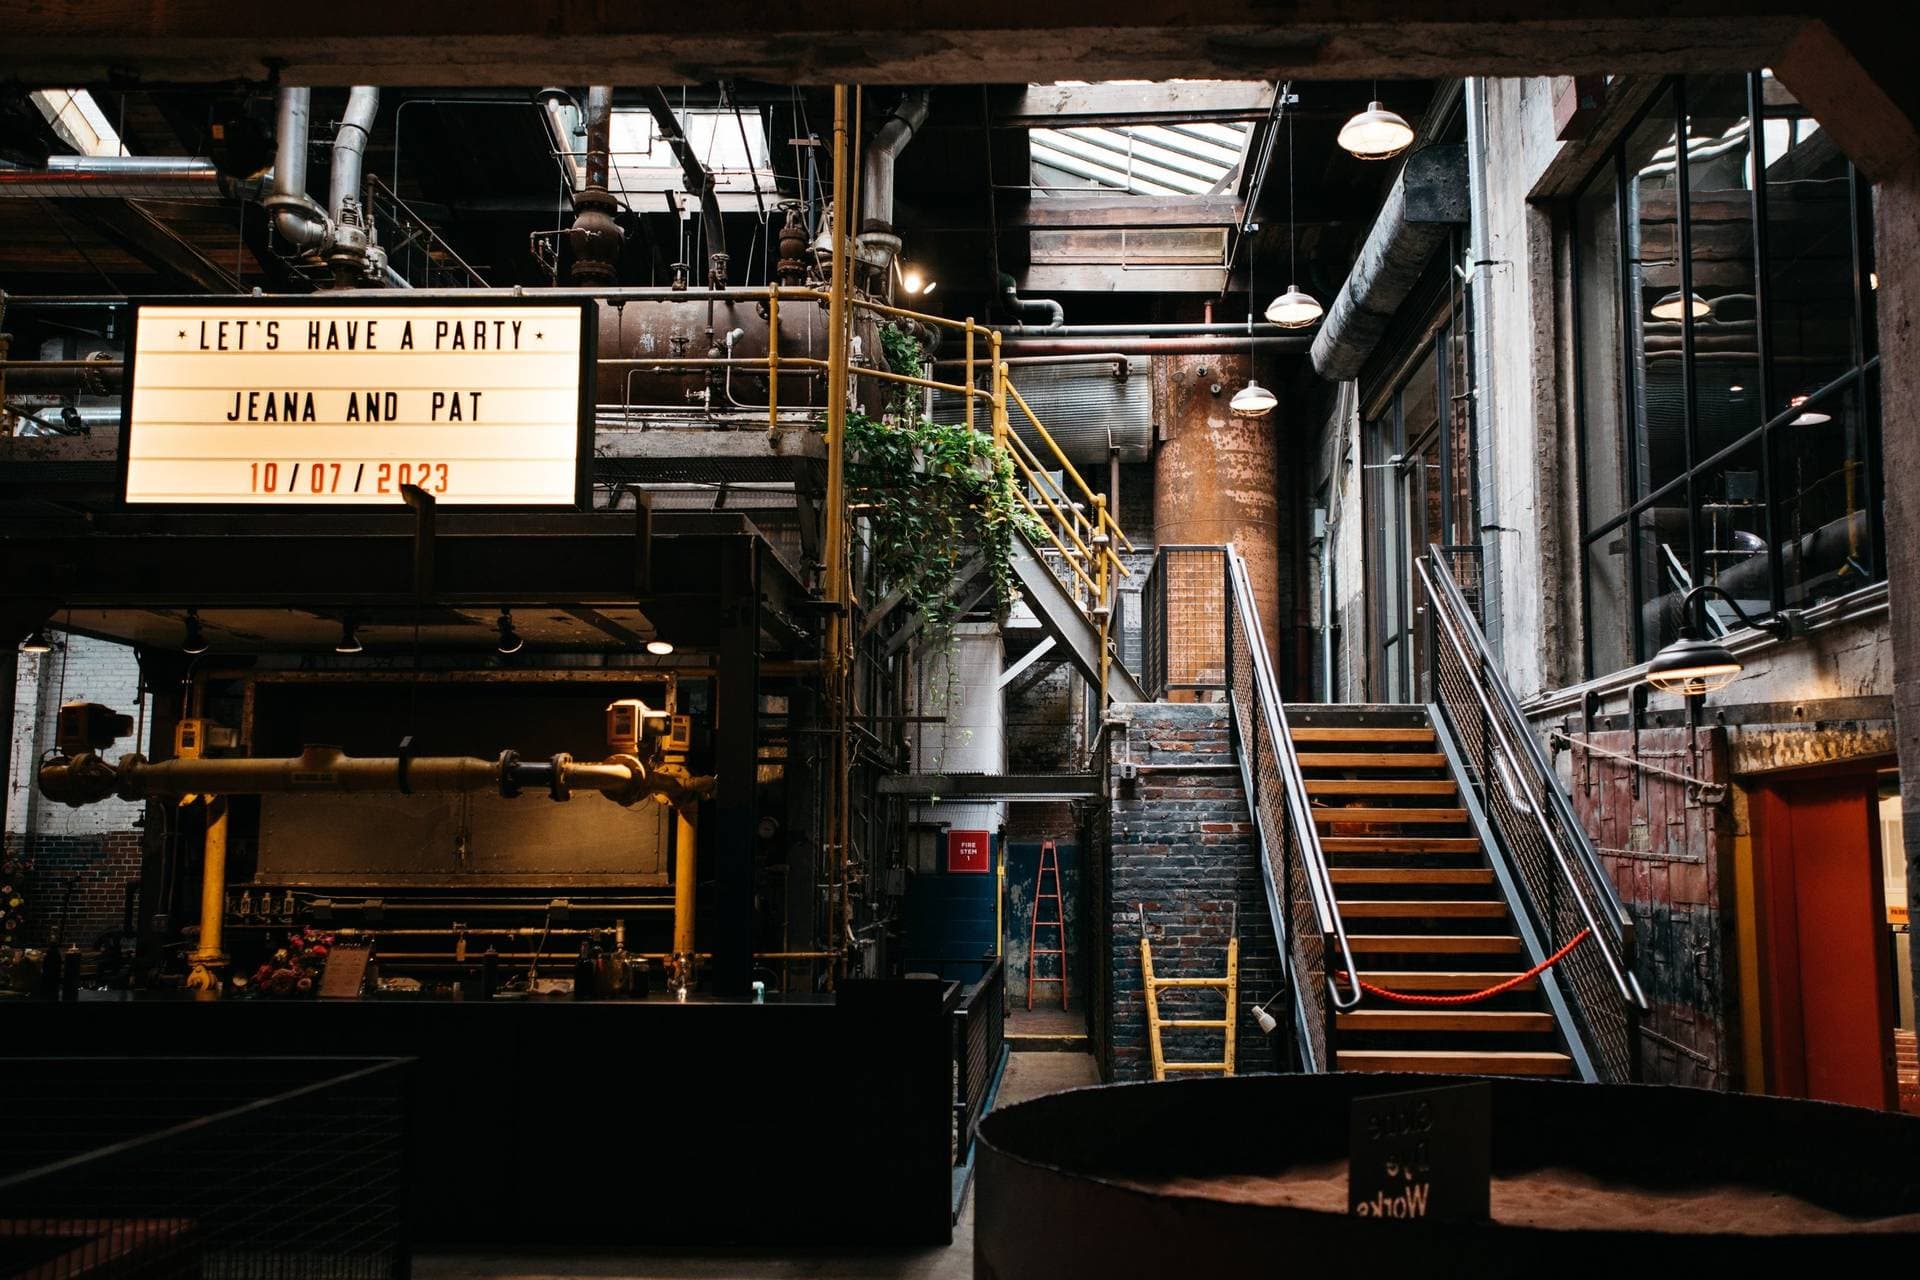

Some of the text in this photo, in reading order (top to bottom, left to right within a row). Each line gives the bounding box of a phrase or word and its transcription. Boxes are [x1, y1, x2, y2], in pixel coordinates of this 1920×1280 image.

[199, 320, 523, 351] LET'S HAVE A PARTY
[226, 391, 483, 422] JEANA AND PAT
